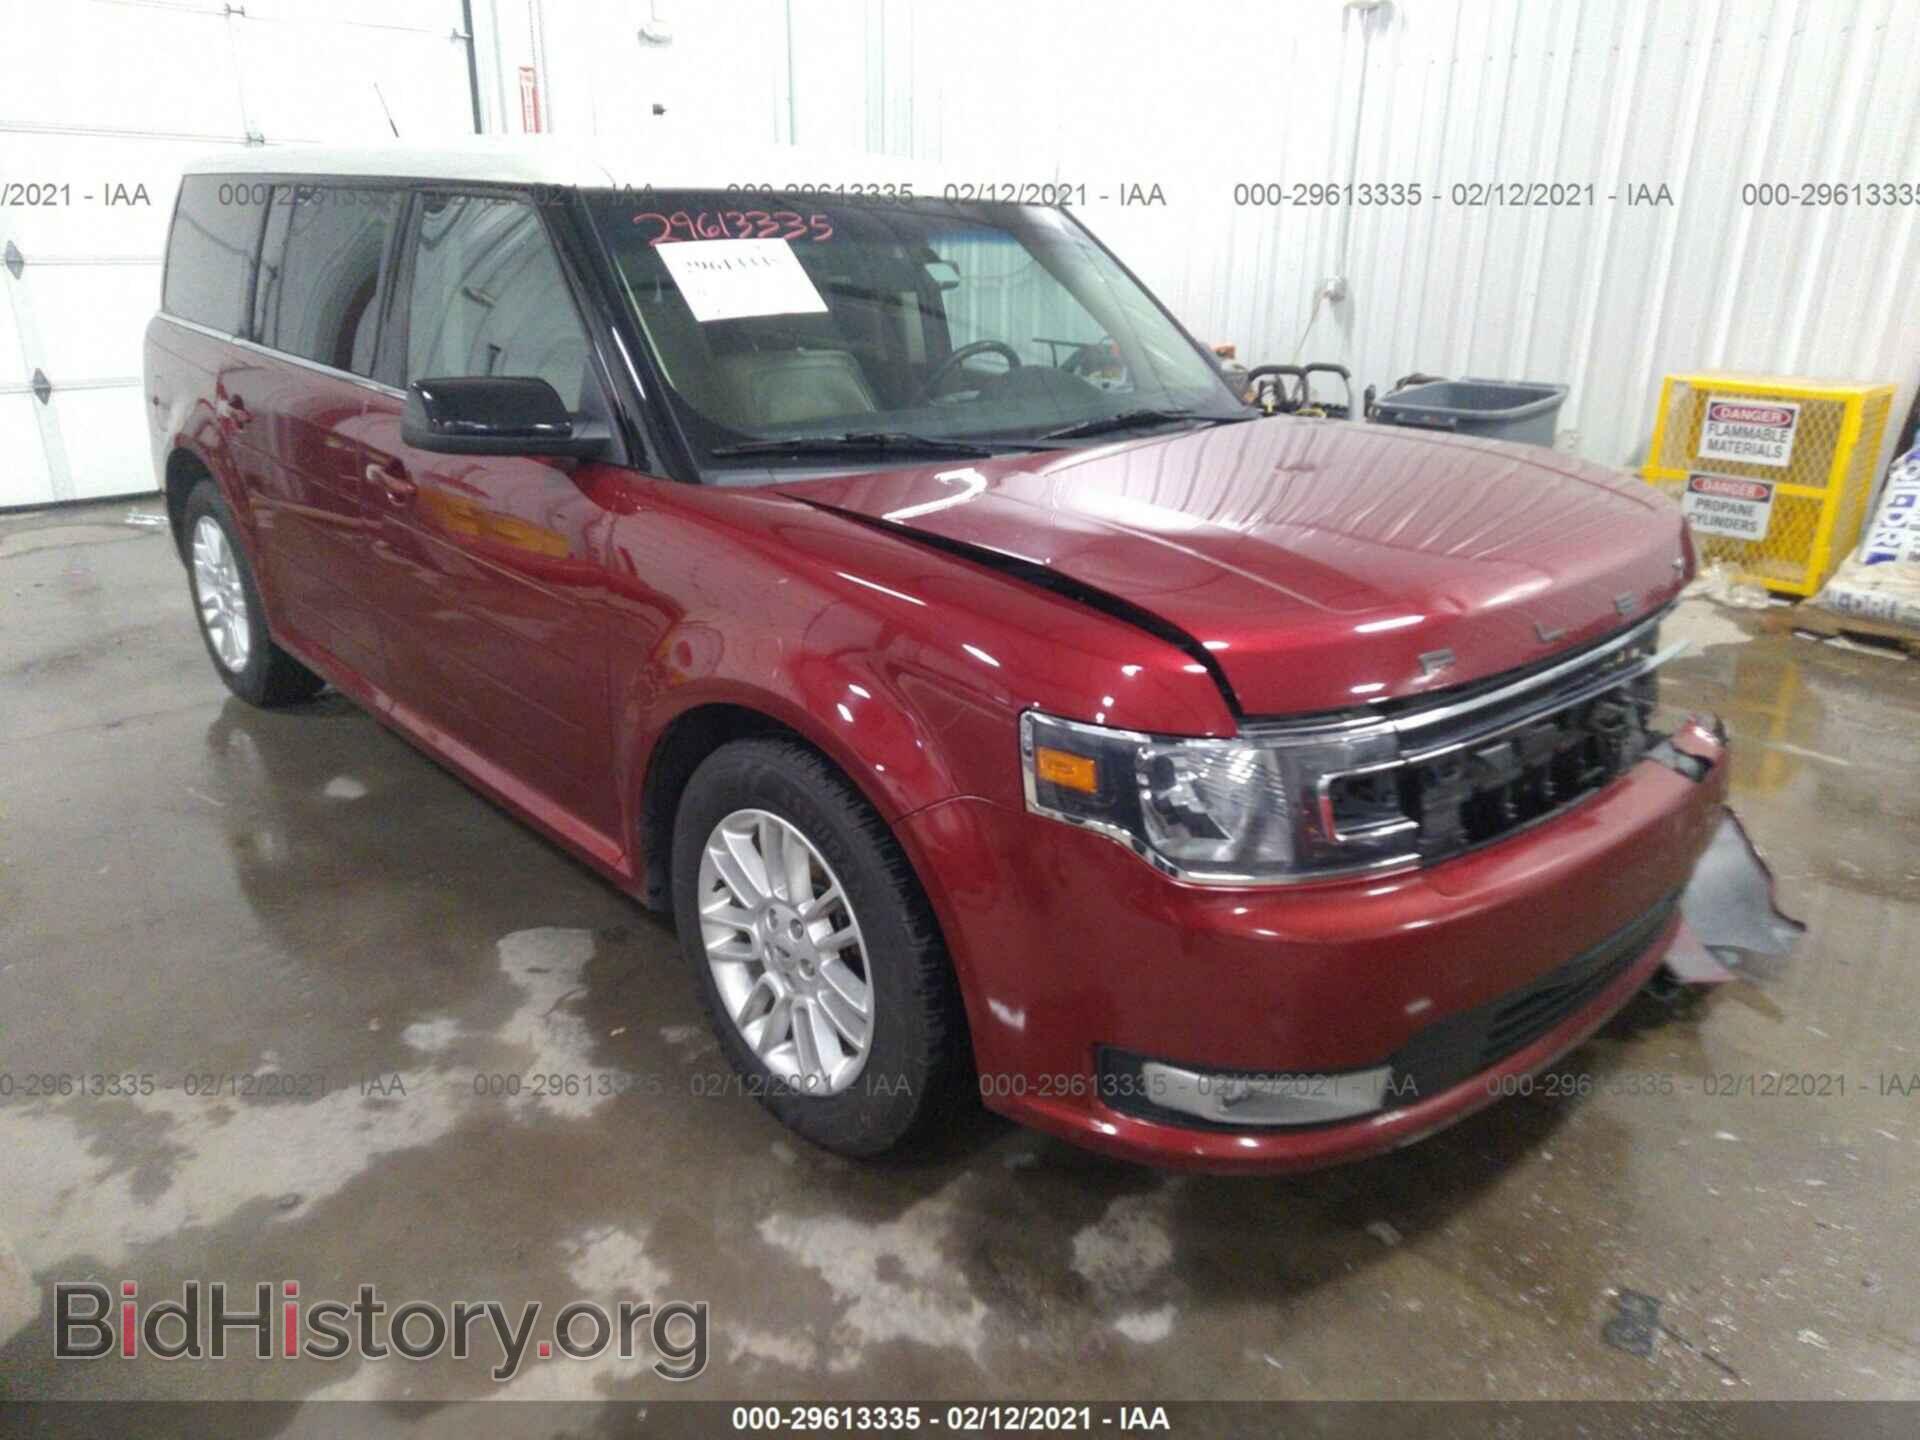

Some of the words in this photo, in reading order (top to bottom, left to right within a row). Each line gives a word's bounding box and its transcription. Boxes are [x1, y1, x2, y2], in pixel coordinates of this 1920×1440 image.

[633, 210, 833, 247] 29613335
[1719, 405, 1781, 424] DANGER
[1707, 423, 1789, 444] FLAMMABLE
[1706, 439, 1783, 458] MATERIALS
[1695, 498, 1757, 517] PROPANE
